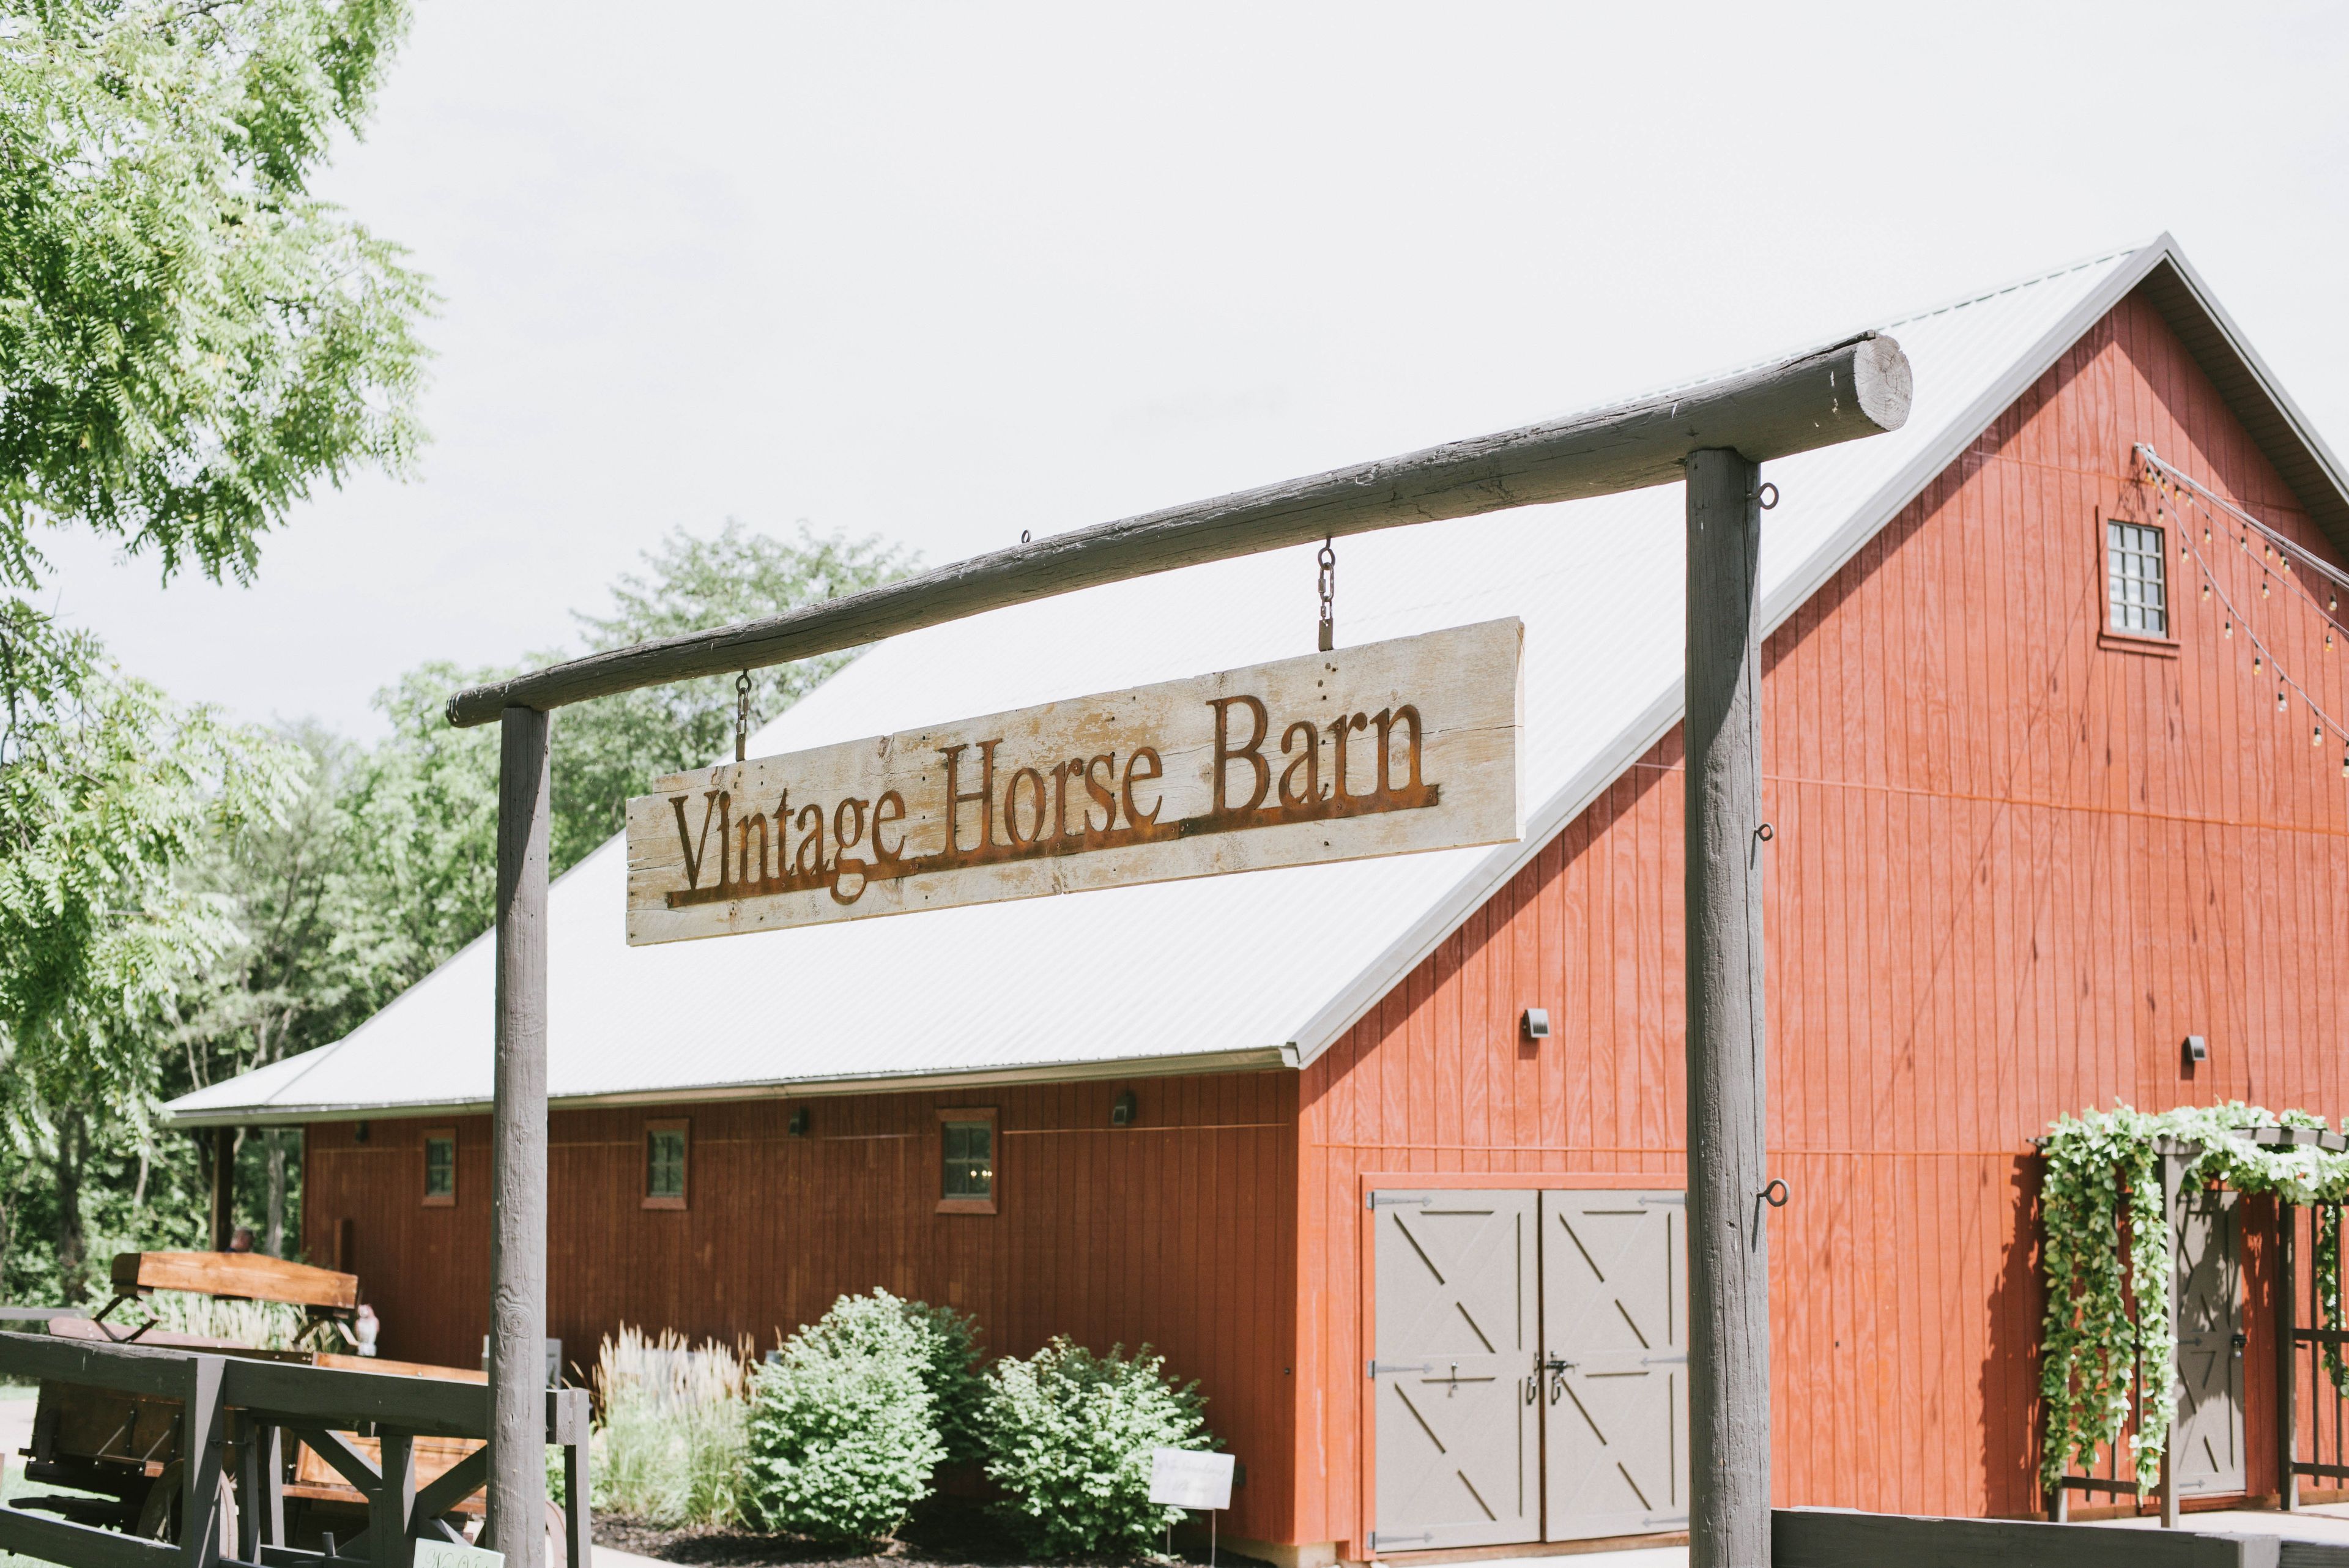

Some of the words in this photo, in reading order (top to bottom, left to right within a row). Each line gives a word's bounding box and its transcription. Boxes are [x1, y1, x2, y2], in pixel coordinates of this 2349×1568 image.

[667, 787, 906, 905] Vintage
[937, 738, 1163, 859] Horse
[1205, 694, 1430, 821] Barn
